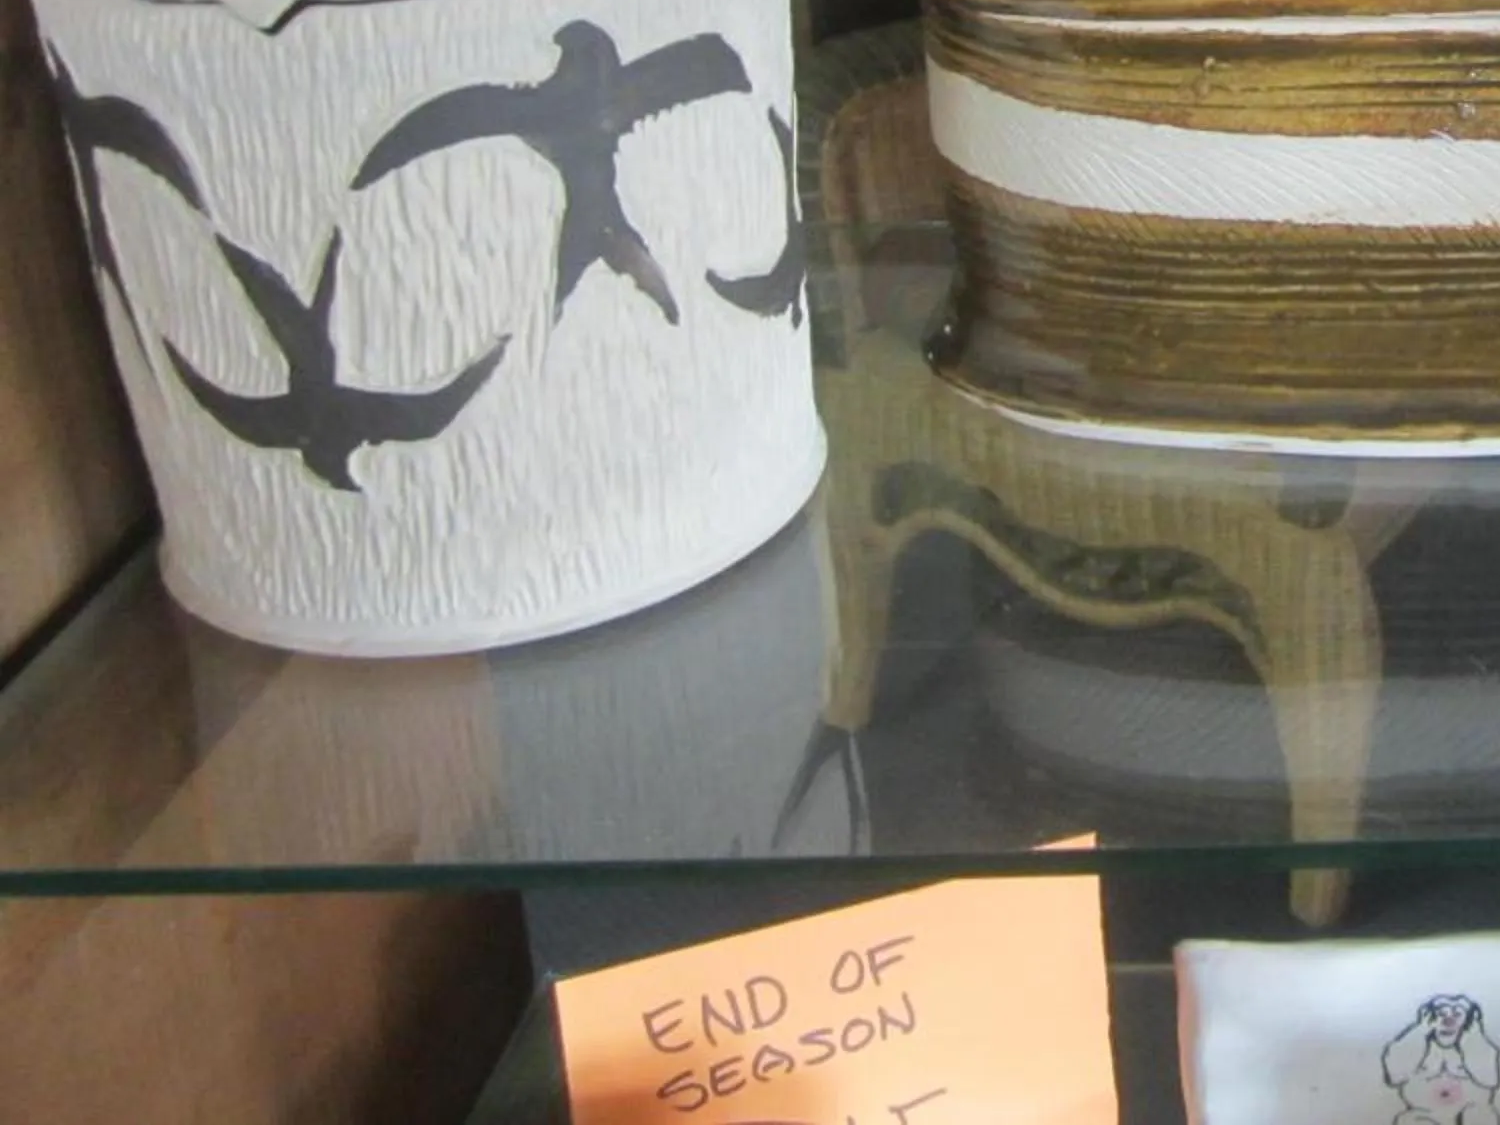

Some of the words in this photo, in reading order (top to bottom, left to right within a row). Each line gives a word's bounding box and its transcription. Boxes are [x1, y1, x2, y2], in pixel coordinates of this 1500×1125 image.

[642, 975, 788, 1054] END
[829, 935, 915, 995] OF
[656, 991, 917, 1113] SEASON
